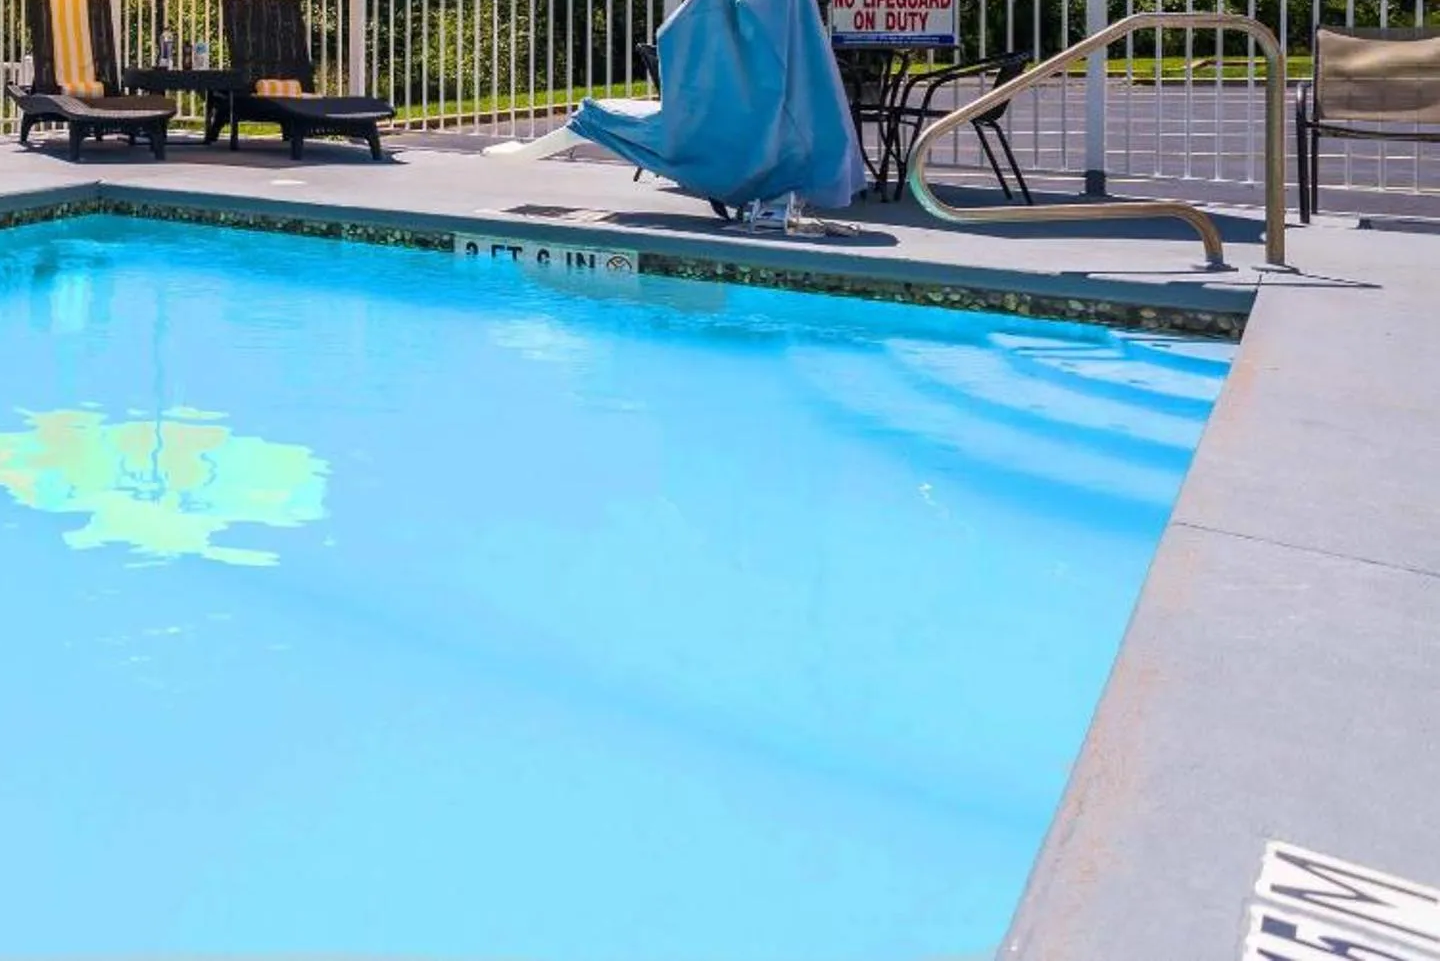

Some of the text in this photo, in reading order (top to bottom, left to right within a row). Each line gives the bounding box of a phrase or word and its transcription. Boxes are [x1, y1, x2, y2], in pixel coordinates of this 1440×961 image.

[854, 12, 929, 31] ON DUTY
[566, 251, 596, 269] IN
